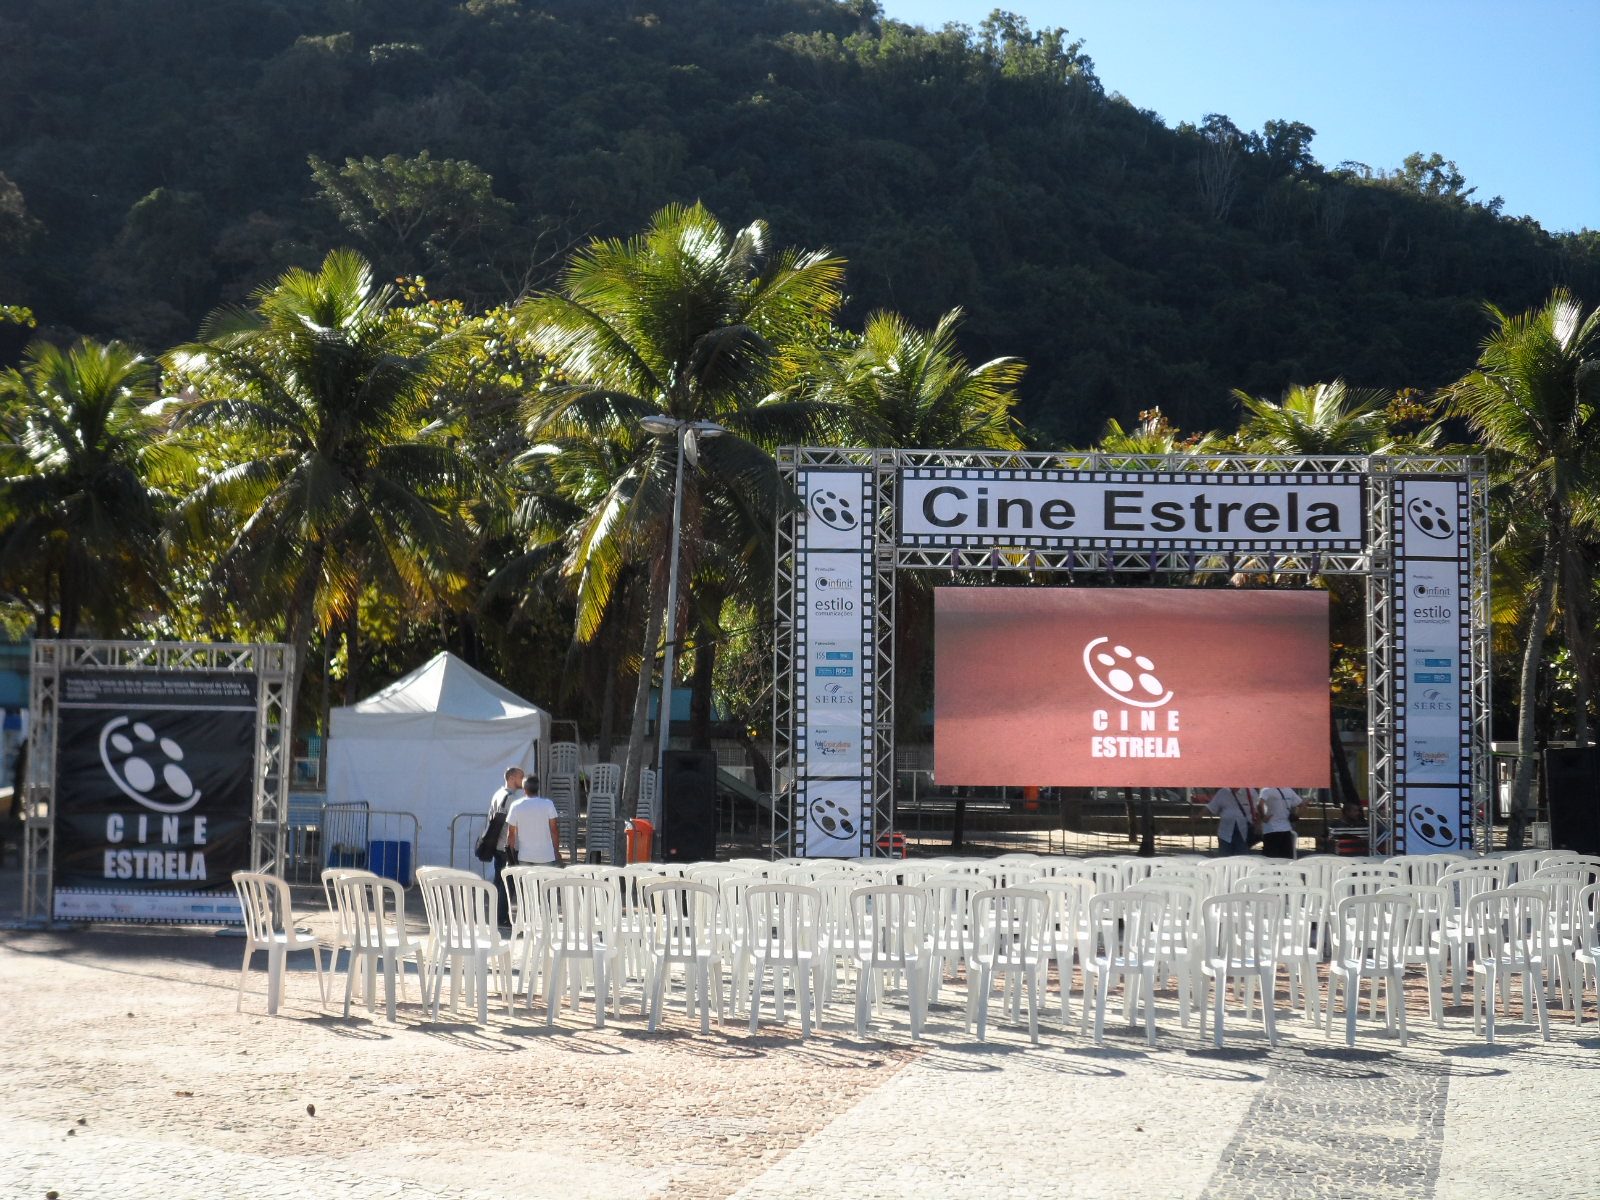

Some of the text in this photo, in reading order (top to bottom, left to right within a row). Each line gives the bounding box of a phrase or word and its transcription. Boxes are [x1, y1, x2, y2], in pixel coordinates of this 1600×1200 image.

[922, 485, 1342, 533] Cine Estrela
[815, 597, 853, 611] estilo
[1414, 605, 1451, 618] estilo
[815, 695, 854, 704] SERES
[1413, 702, 1452, 711] SERES
[1092, 709, 1180, 731] CINE
[1091, 736, 1181, 758] ESTRELA
[106, 812, 208, 845] CINE
[104, 849, 207, 881] ESTRELA
